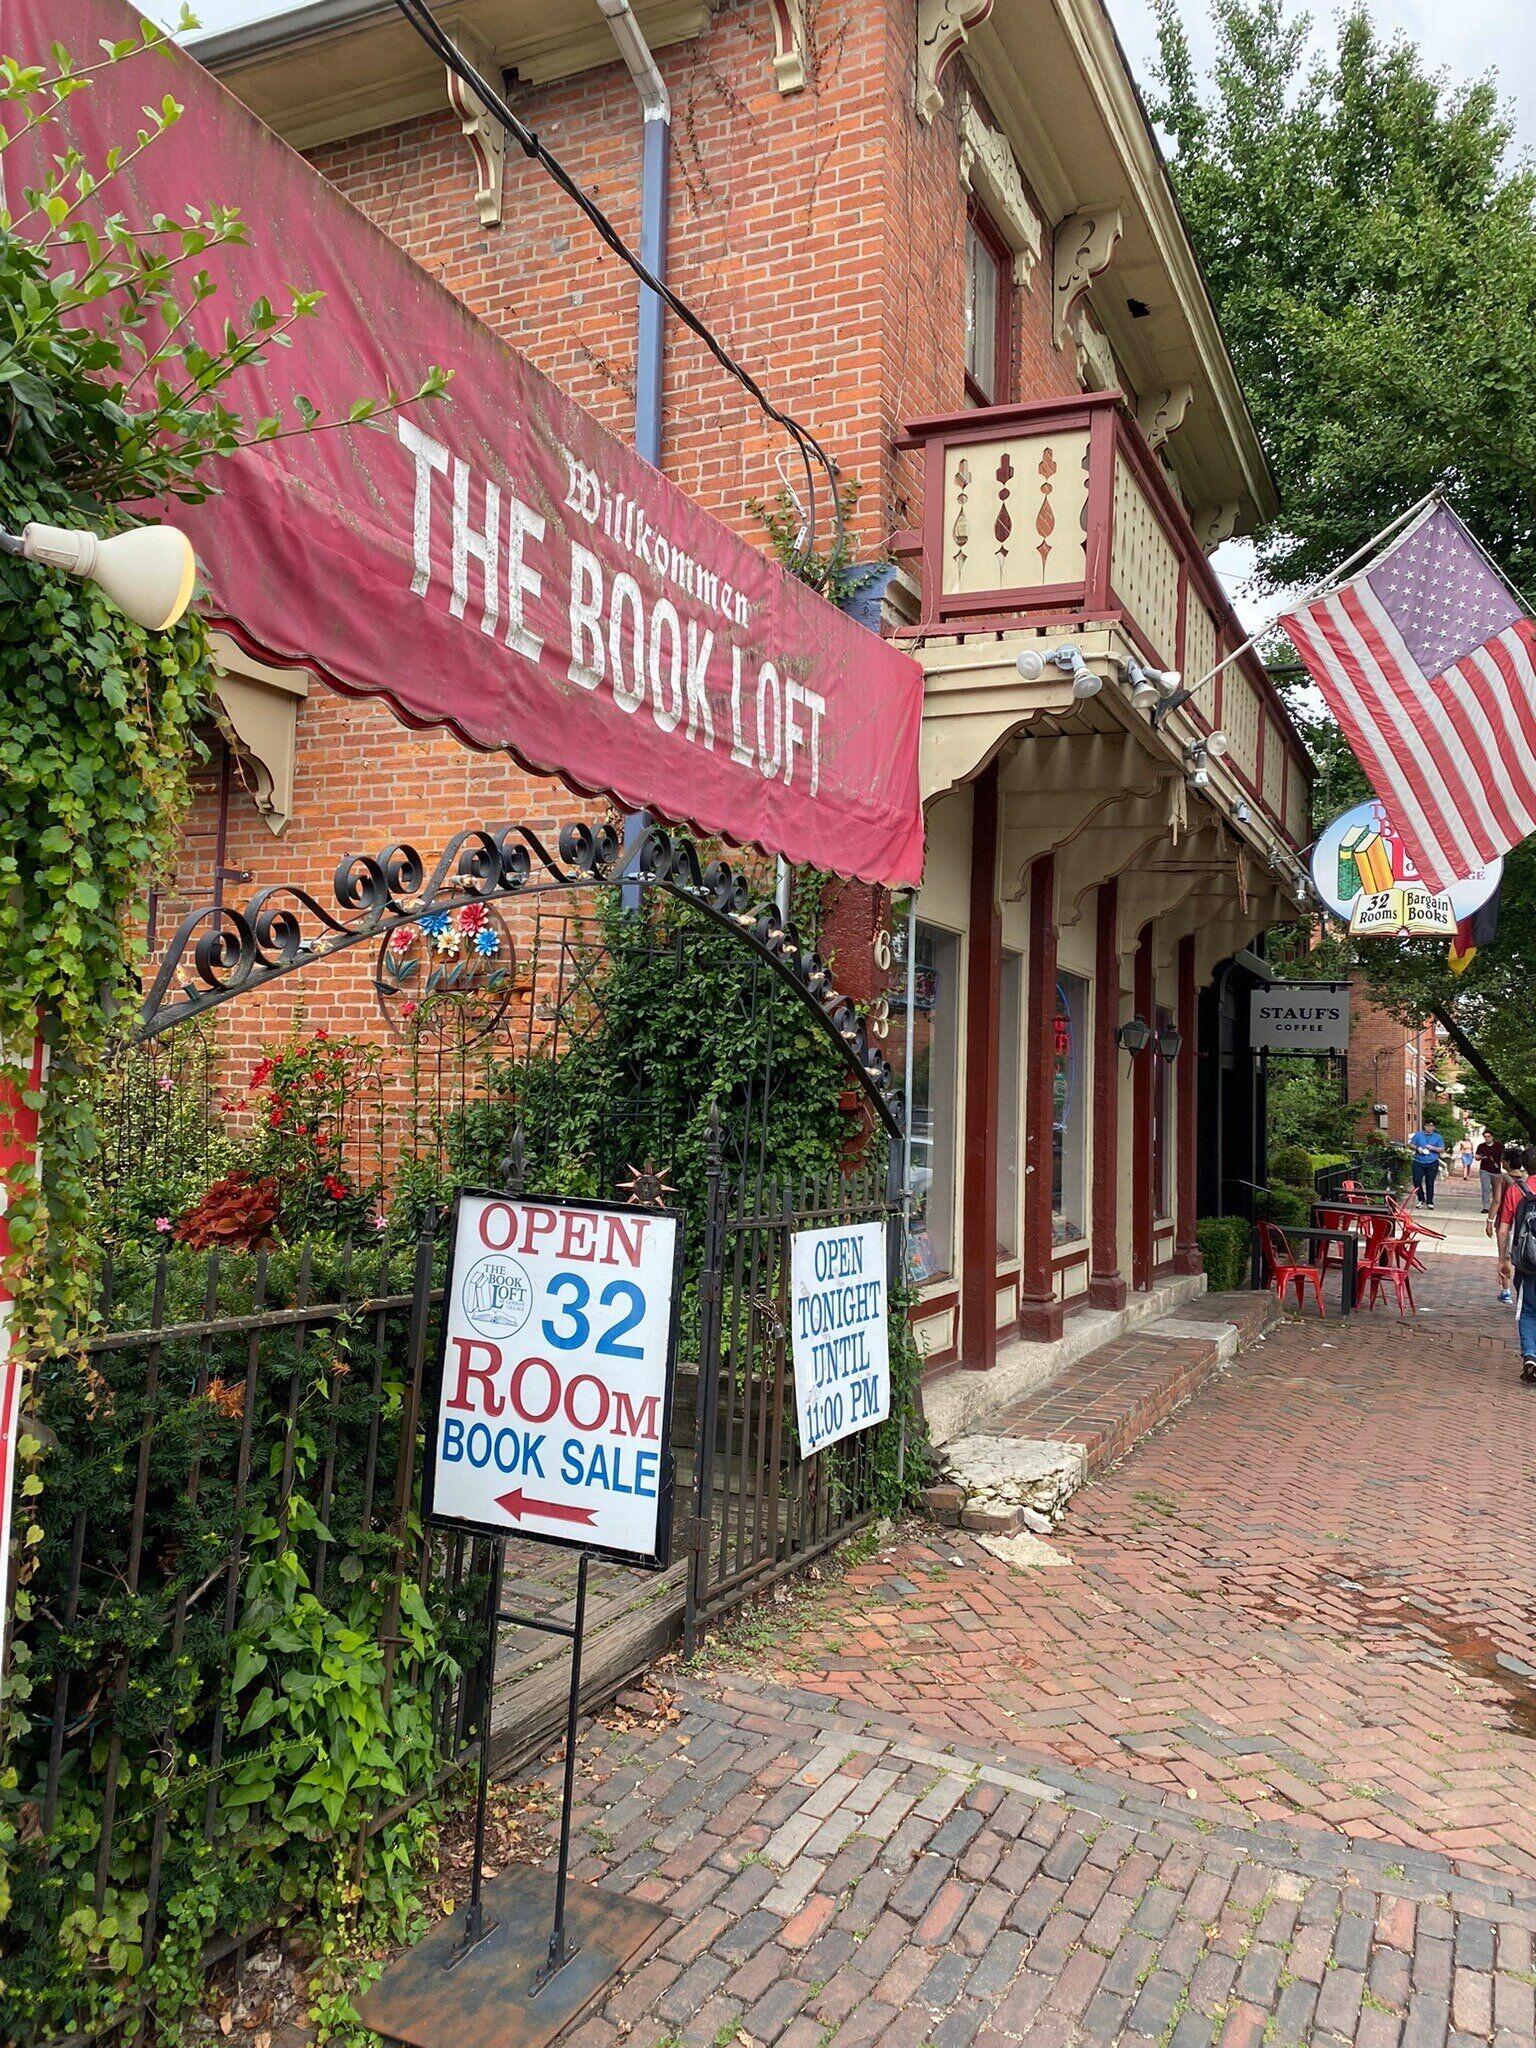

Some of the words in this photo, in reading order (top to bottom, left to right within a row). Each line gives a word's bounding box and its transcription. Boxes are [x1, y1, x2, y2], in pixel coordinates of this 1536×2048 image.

[564, 451, 749, 628] Willkommen
[399, 416, 546, 664] THE
[567, 539, 715, 750] BOOK
[731, 644, 826, 797] LOFT
[1359, 908, 1398, 924] Rooms
[1367, 893, 1390, 912] 32
[1407, 892, 1449, 911] Bargain
[1408, 908, 1448, 924] Books
[1259, 1006, 1340, 1020] STAUF'S
[1275, 1024, 1324, 1032] COFFEE
[478, 1202, 651, 1268] OPEN
[814, 1235, 864, 1283] OPEN
[484, 1263, 507, 1275] THE
[488, 1273, 522, 1288] BOOK
[491, 1284, 527, 1309] LOFT
[541, 1272, 647, 1360] 32
[798, 1280, 881, 1340] TONIGHT
[811, 1331, 870, 1388] UNTIL
[446, 1337, 661, 1440] ROOM
[806, 1392, 843, 1444] 11:00
[850, 1374, 880, 1424] PM
[443, 1418, 546, 1480] BOOK
[561, 1438, 659, 1498] SALE
